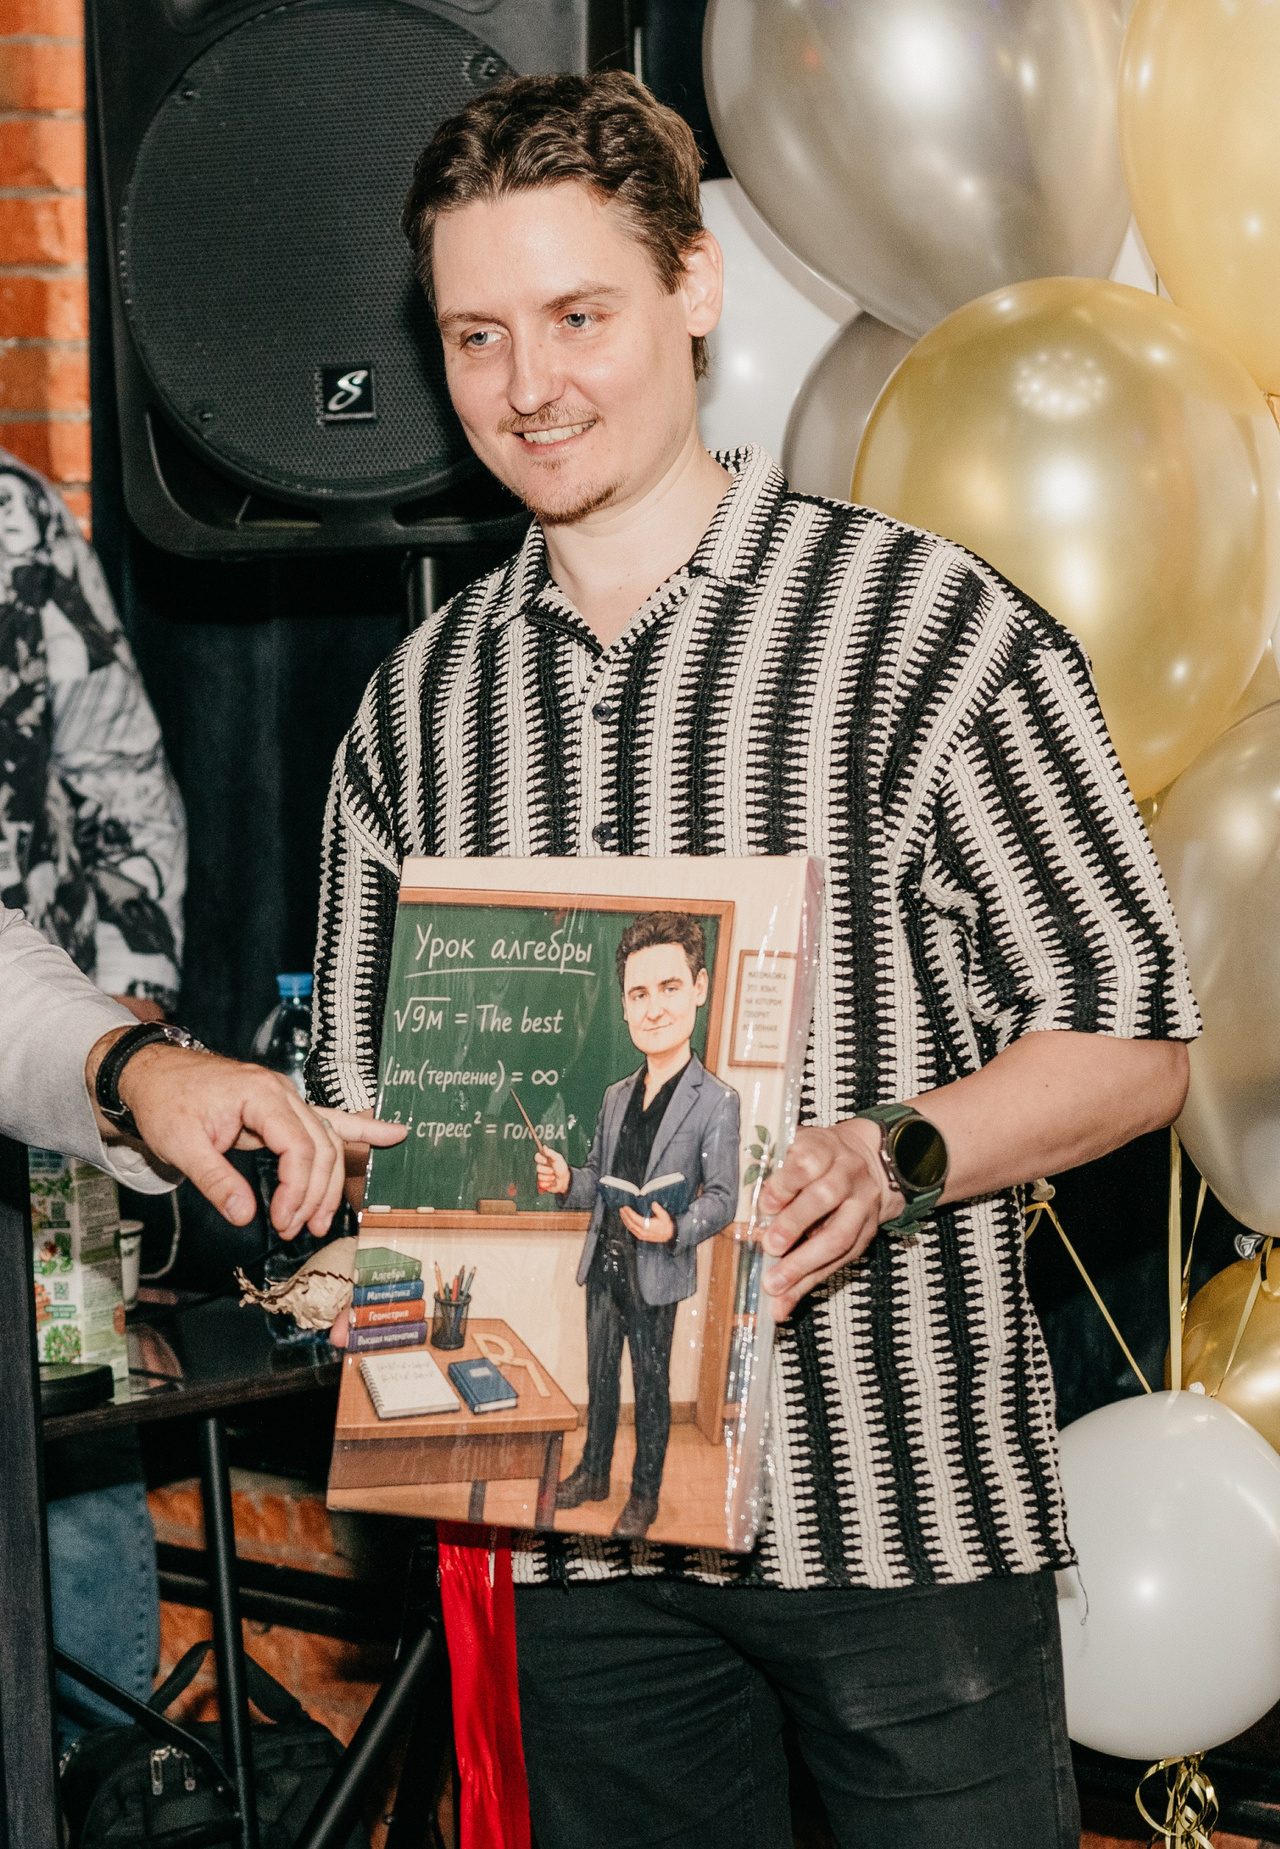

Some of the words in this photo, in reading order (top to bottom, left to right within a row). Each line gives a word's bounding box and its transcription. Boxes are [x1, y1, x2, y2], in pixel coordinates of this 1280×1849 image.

[415, 922, 476, 969] Урок
[490, 929, 593, 974] алгебры
[476, 1004, 513, 1033] The
[520, 1005, 564, 1033] best
[384, 1055, 506, 1093] lim(терпение)
[371, 1268, 406, 1282] Алгебра
[366, 1289, 411, 1301] Математика
[369, 1309, 409, 1322] Геометрия
